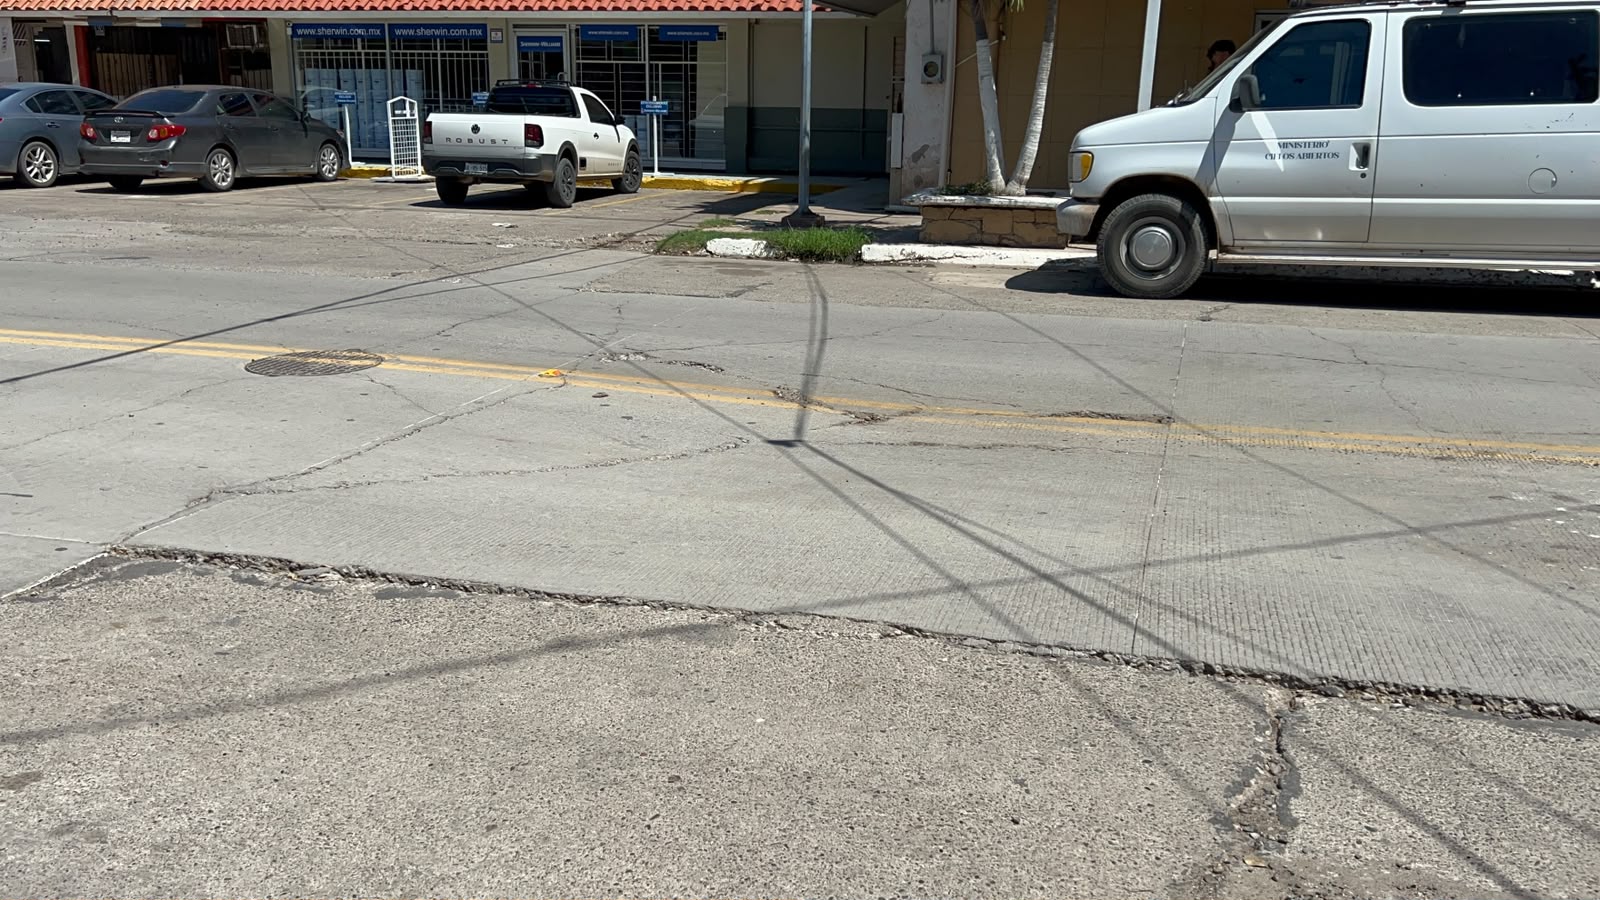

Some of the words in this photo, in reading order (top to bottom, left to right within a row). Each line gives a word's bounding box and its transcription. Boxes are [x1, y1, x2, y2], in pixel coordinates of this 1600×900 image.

[296, 26, 381, 36] www.sherwin.com.mx
[394, 26, 482, 36] www.sherwin.com.mx
[1277, 141, 1330, 149] MINISTERIO
[1297, 152, 1340, 160] ABIERTOS
